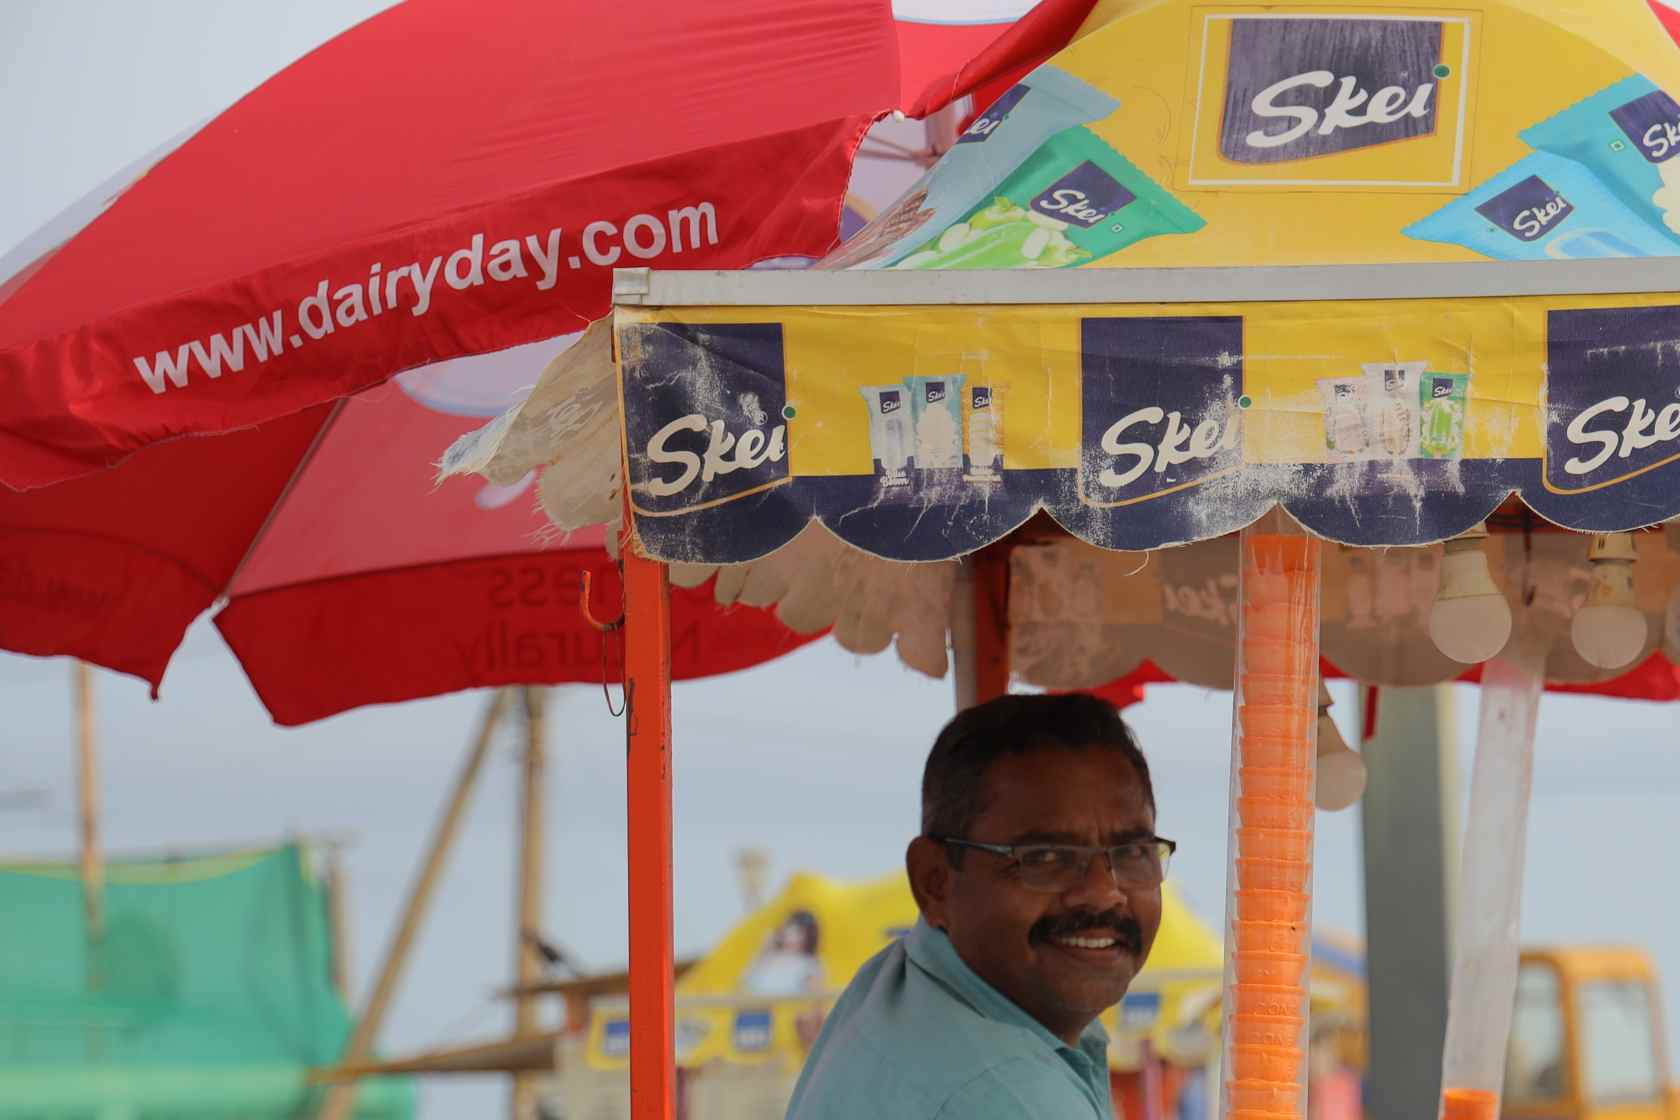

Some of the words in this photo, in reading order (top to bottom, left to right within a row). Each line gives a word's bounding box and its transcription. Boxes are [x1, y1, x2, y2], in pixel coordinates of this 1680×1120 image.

[1246, 64, 1450, 148] Skei
[1040, 189, 1105, 223] Skei
[1513, 190, 1567, 238] Skei
[133, 201, 720, 395] www.dairyday.com
[647, 405, 797, 497] Skei
[1100, 394, 1252, 488] Skei
